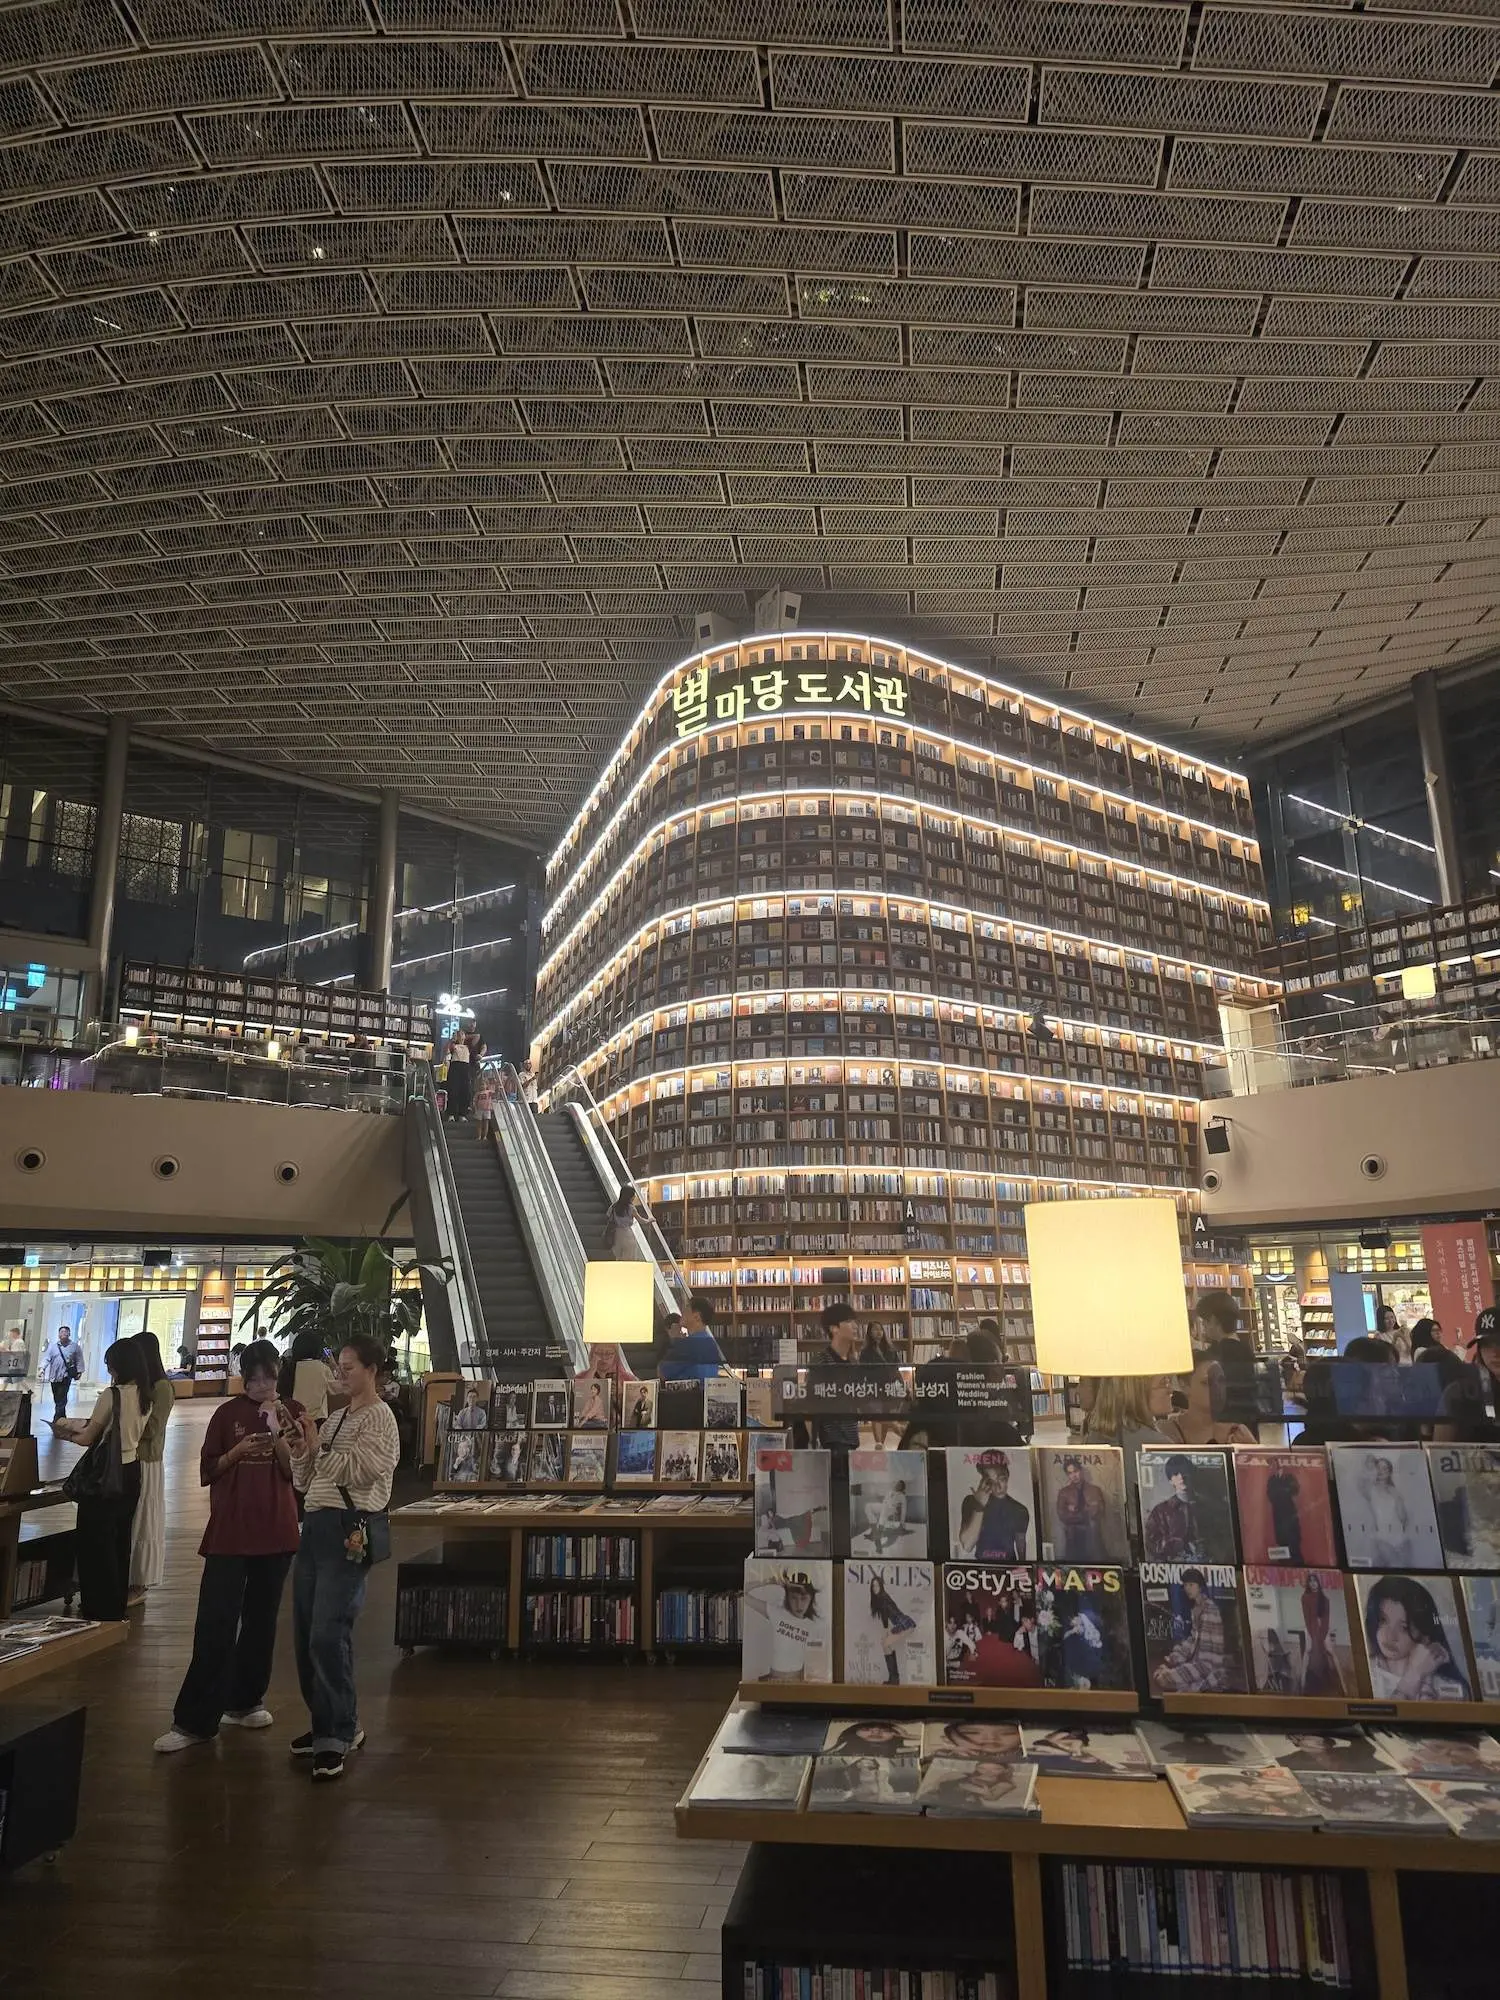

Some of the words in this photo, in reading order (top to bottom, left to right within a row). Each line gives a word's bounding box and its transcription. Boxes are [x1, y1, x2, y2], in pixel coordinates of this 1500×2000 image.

[672, 667, 788, 737] 별마당
[794, 670, 908, 717] 도서관
[906, 1200, 914, 1218] A
[1195, 1217, 1206, 1231] A
[922, 1261, 951, 1270] 비즈니스
[957, 1372, 985, 1380] Fashion
[957, 1390, 989, 1399] Wedding
[978, 1400, 1008, 1408] magazine
[963, 1454, 1010, 1465] ARENA
[1053, 1454, 1103, 1465] ARENA
[1141, 1454, 1223, 1466] Esire
[848, 1564, 931, 1587] SINGLES
[1036, 1567, 1121, 1592] MAPS
[1142, 1563, 1237, 1588] COSMOITAN
[946, 1569, 1032, 1596] @Style
